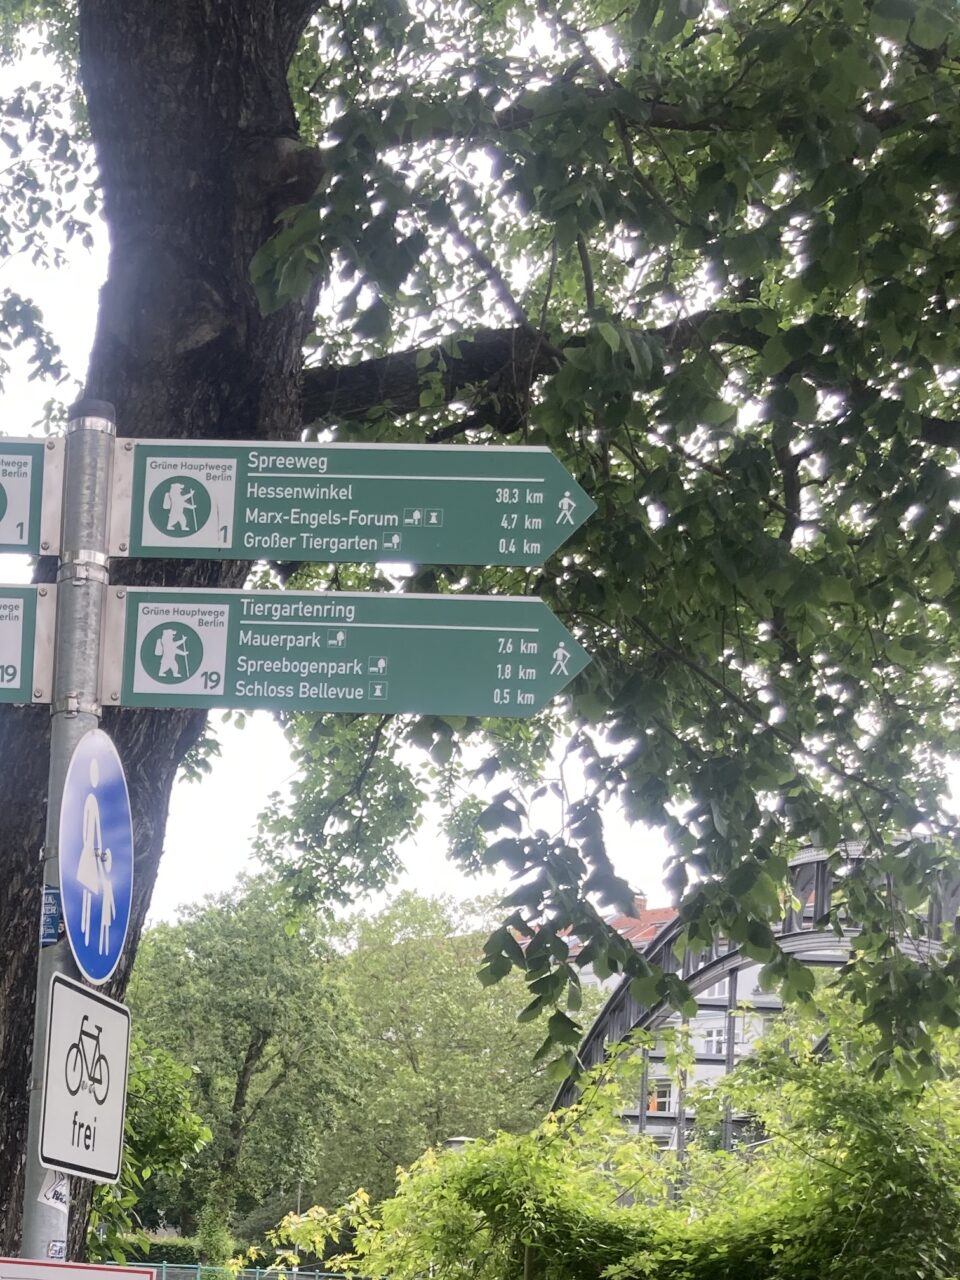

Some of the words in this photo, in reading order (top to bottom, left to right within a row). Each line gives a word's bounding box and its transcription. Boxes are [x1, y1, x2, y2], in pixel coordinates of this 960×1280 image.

[149, 461, 178, 471] Grüne
[180, 461, 233, 473] Hauptwege
[247, 452, 328, 473] Spreeweg
[1, 468, 28, 478] Berlin
[205, 472, 233, 482] Berlin
[246, 483, 353, 500] Hessenwinkel
[526, 489, 543, 504] km
[245, 508, 398, 527] Marx-Engels-Forum
[501, 514, 517, 529] 4,7
[525, 515, 542, 530] km
[16, 522, 24, 540] 1
[219, 525, 228, 544] 1
[243, 533, 297, 551] Großer
[300, 533, 378, 554] Tiergarten
[499, 538, 516, 554] 0,4
[523, 539, 541, 554] km
[142, 606, 170, 616] Grüne
[173, 607, 225, 619] Hauptwege
[241, 598, 355, 622] Tiergartenring
[198, 617, 224, 628] Berlin
[239, 630, 321, 650] Mauerpark
[520, 639, 538, 654] km
[237, 656, 362, 678] Spreebogenpark
[496, 664, 512, 680] 1,8
[518, 665, 536, 680] km
[200, 671, 221, 690] 19
[235, 681, 297, 698] Schloss
[299, 682, 364, 700] Bellevue
[493, 689, 511, 704] 0,5
[517, 689, 535, 705] km
[72, 1111, 98, 1152] frei
